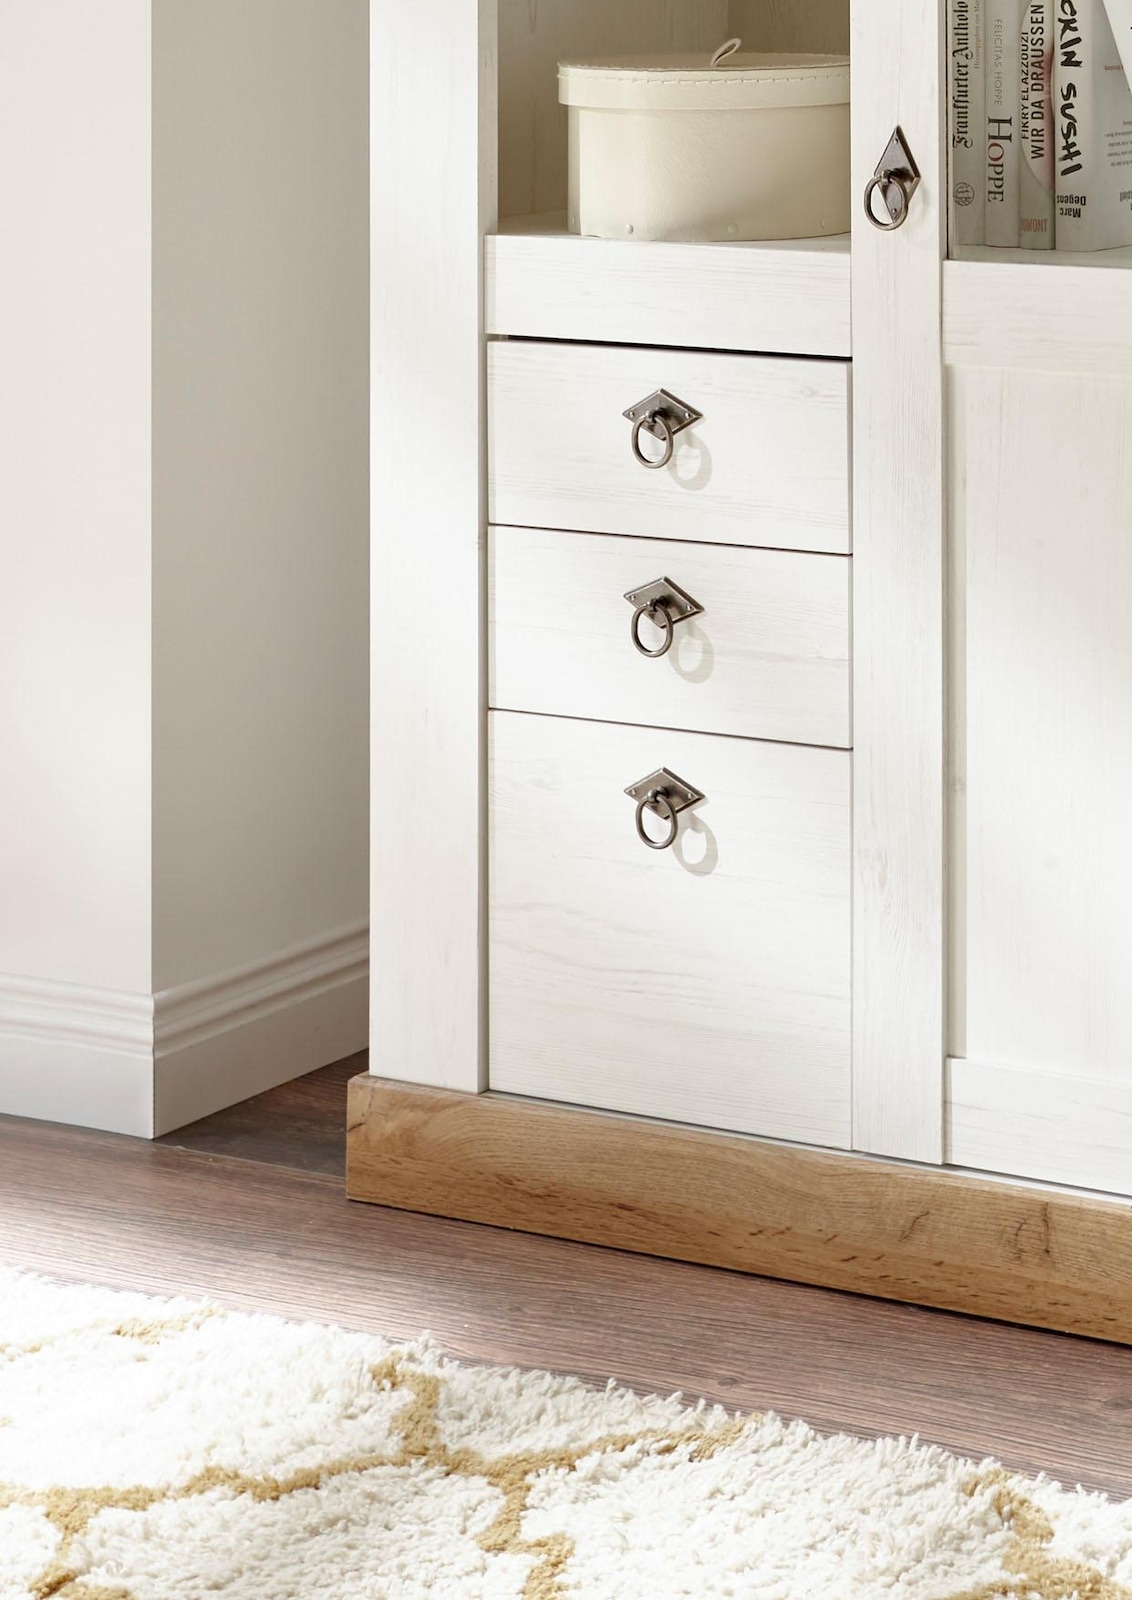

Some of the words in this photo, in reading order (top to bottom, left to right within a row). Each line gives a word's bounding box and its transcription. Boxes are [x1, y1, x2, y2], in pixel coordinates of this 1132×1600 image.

[994, 19, 1003, 68] FELICITAS
[1031, 4, 1044, 92] DRAUSSEN
[952, 62, 973, 149] Frankfurter
[994, 71, 1003, 106] HOPPE
[1021, 103, 1029, 140] FIKRY
[1031, 100, 1045, 121] DA
[1031, 127, 1045, 160] WIR
[1059, 82, 1083, 177] SUSHI
[987, 116, 1013, 203] HOPPE
[1056, 195, 1087, 206] Degens
[1060, 208, 1082, 218] Marc
